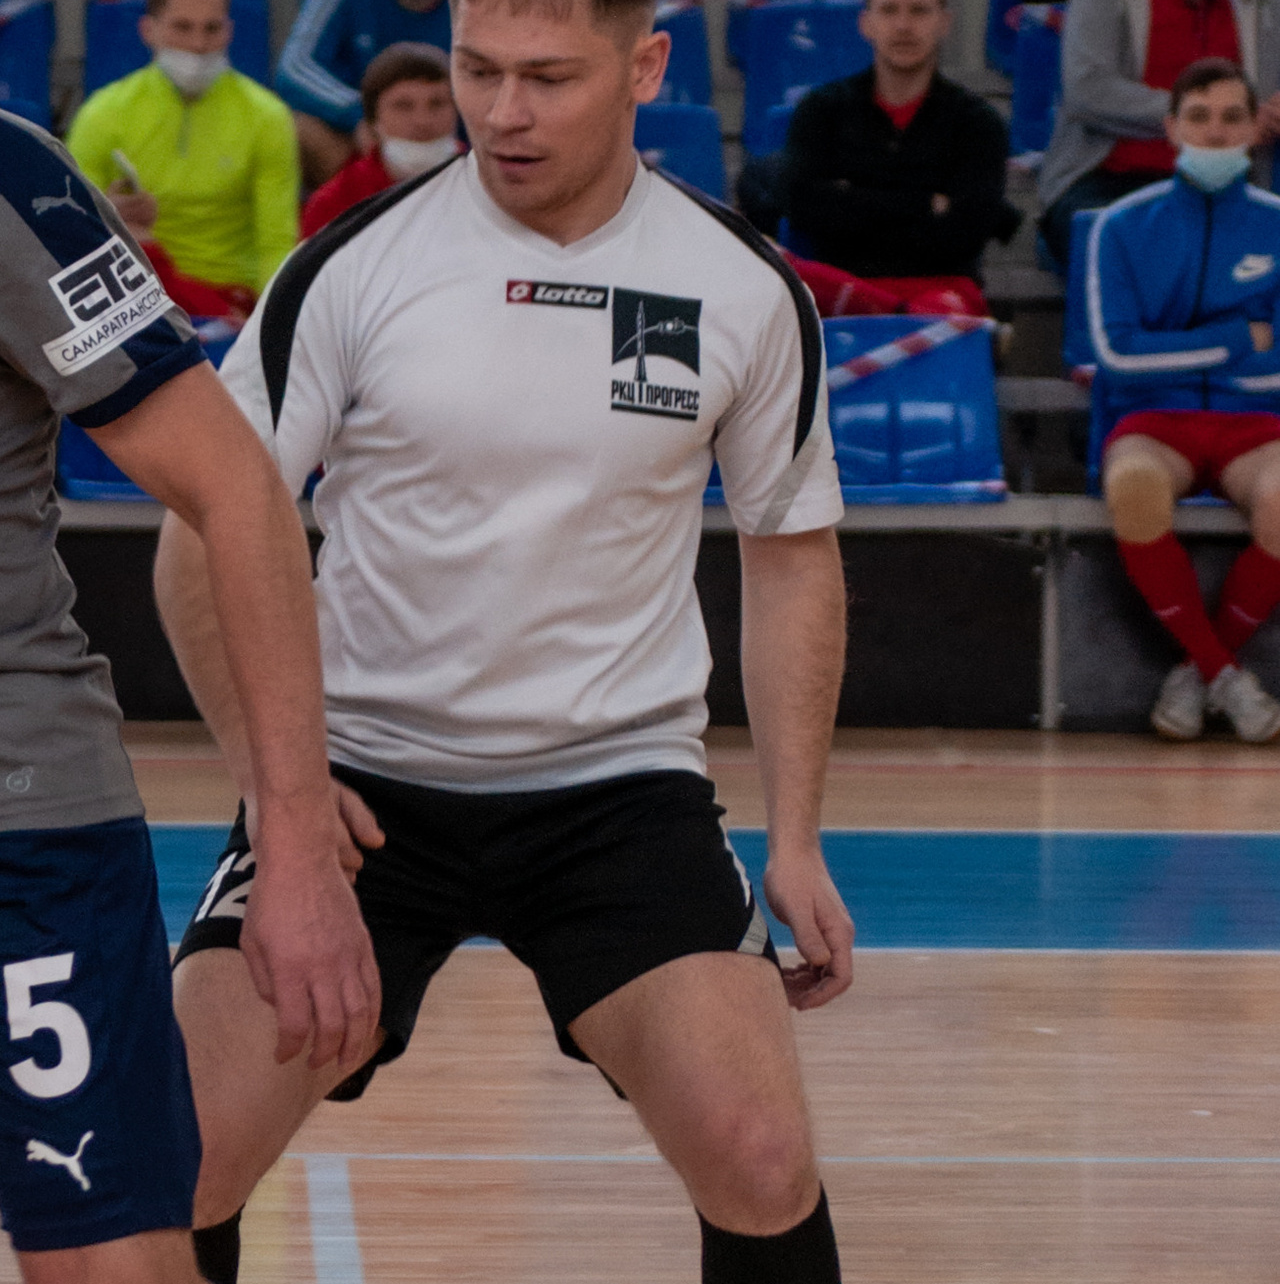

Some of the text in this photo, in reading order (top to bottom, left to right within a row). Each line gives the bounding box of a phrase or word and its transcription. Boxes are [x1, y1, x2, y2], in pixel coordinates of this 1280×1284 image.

[611, 379, 700, 411] РКЦ ПРОГРЕСС
[3, 951, 92, 1099] 5
